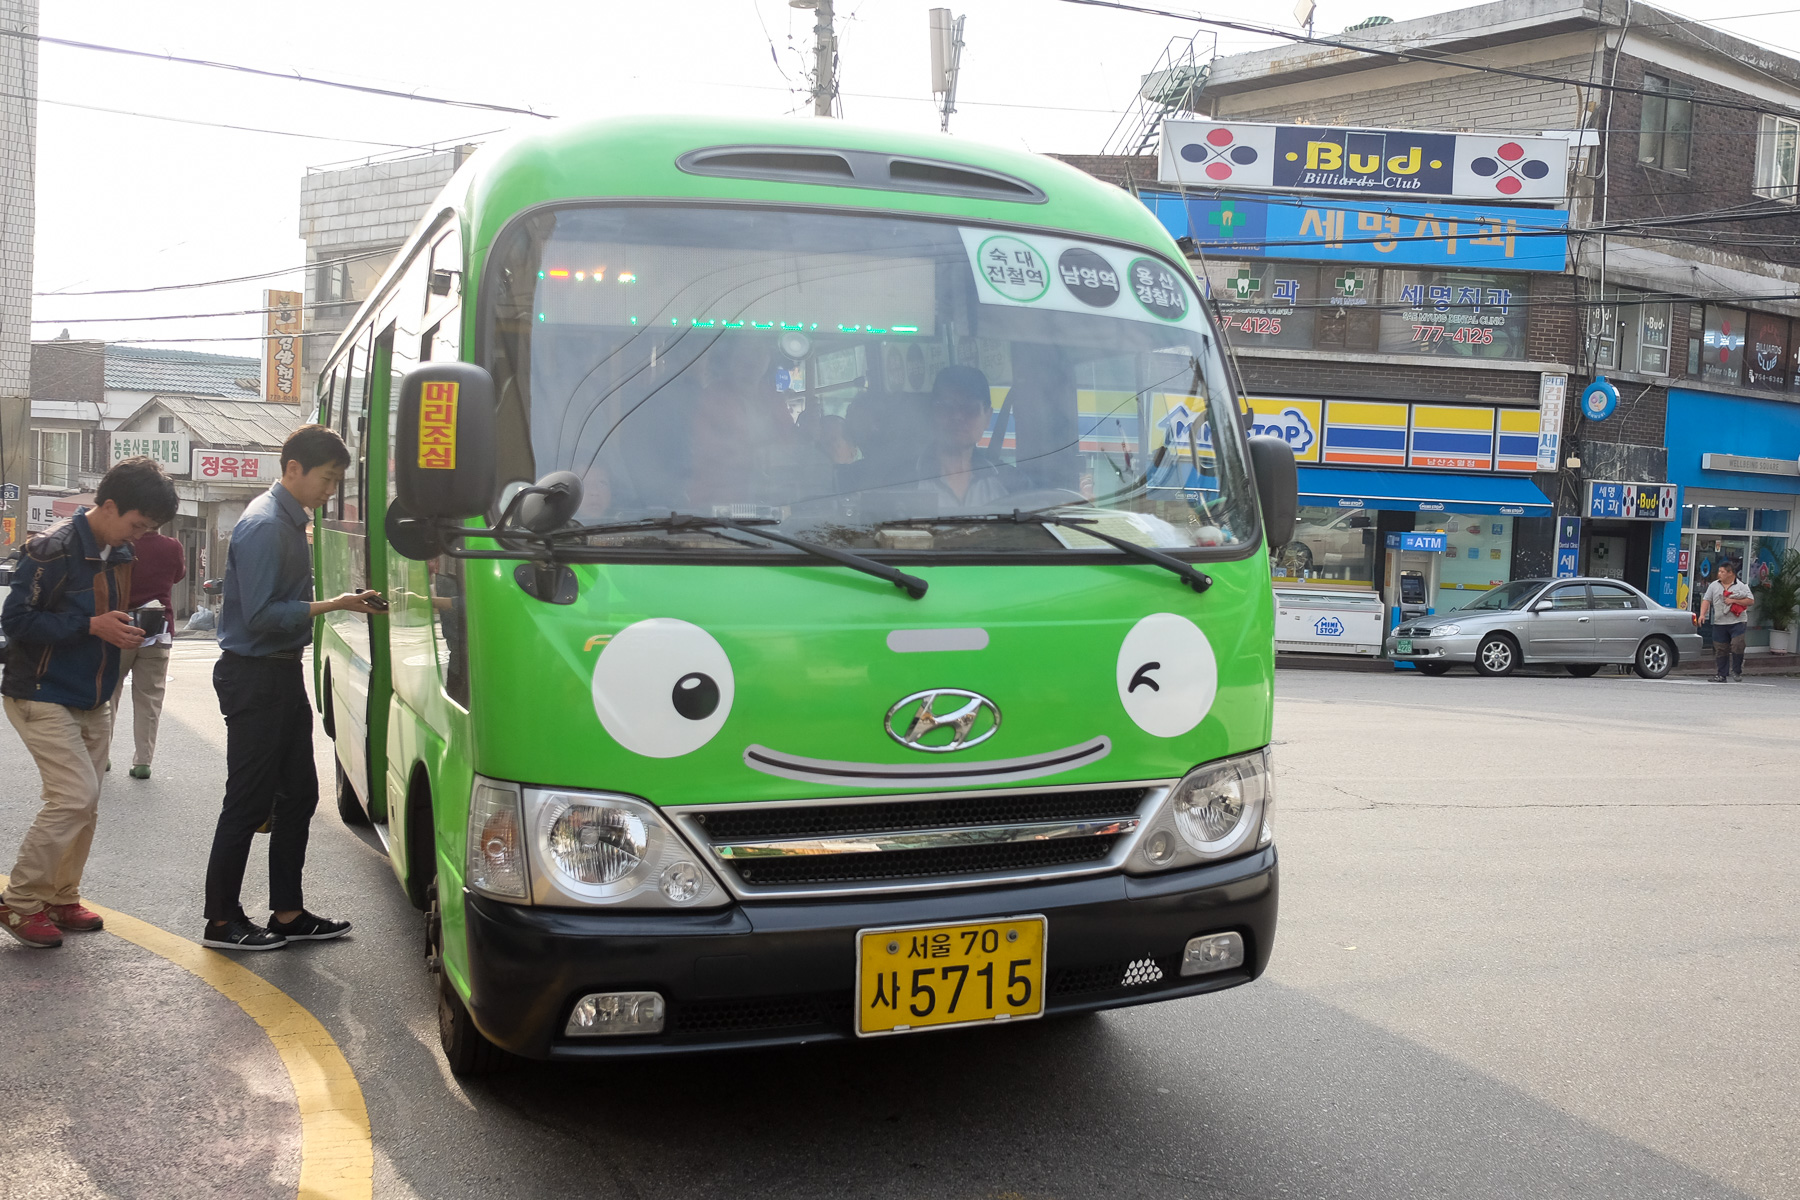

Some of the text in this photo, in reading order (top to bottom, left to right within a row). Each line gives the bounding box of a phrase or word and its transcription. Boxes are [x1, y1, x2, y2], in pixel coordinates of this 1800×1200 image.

[1303, 172, 1421, 190] Billiards Club
[988, 248, 1034, 268] 숙대
[987, 265, 1044, 288] 전철역
[1059, 265, 1119, 292] 남영역
[1136, 267, 1174, 290] 용산
[1136, 285, 1185, 311] 경찰서
[1399, 284, 1513, 315] 세명치과
[1402, 311, 1505, 326] SAE MYUNG DENTAL CLINIC
[1411, 325, 1493, 344] 777-4125
[1756, 342, 1782, 354] BILLIARDS
[1757, 352, 1778, 371] CLUB
[422, 383, 456, 468] 머리조심
[201, 456, 259, 478] 정육점
[1759, 461, 1780, 471] SQUARE
[1599, 487, 1616, 498] 세명
[1593, 499, 1620, 514] 치과
[1414, 537, 1442, 548] ATM
[908, 929, 998, 960] 서울 70
